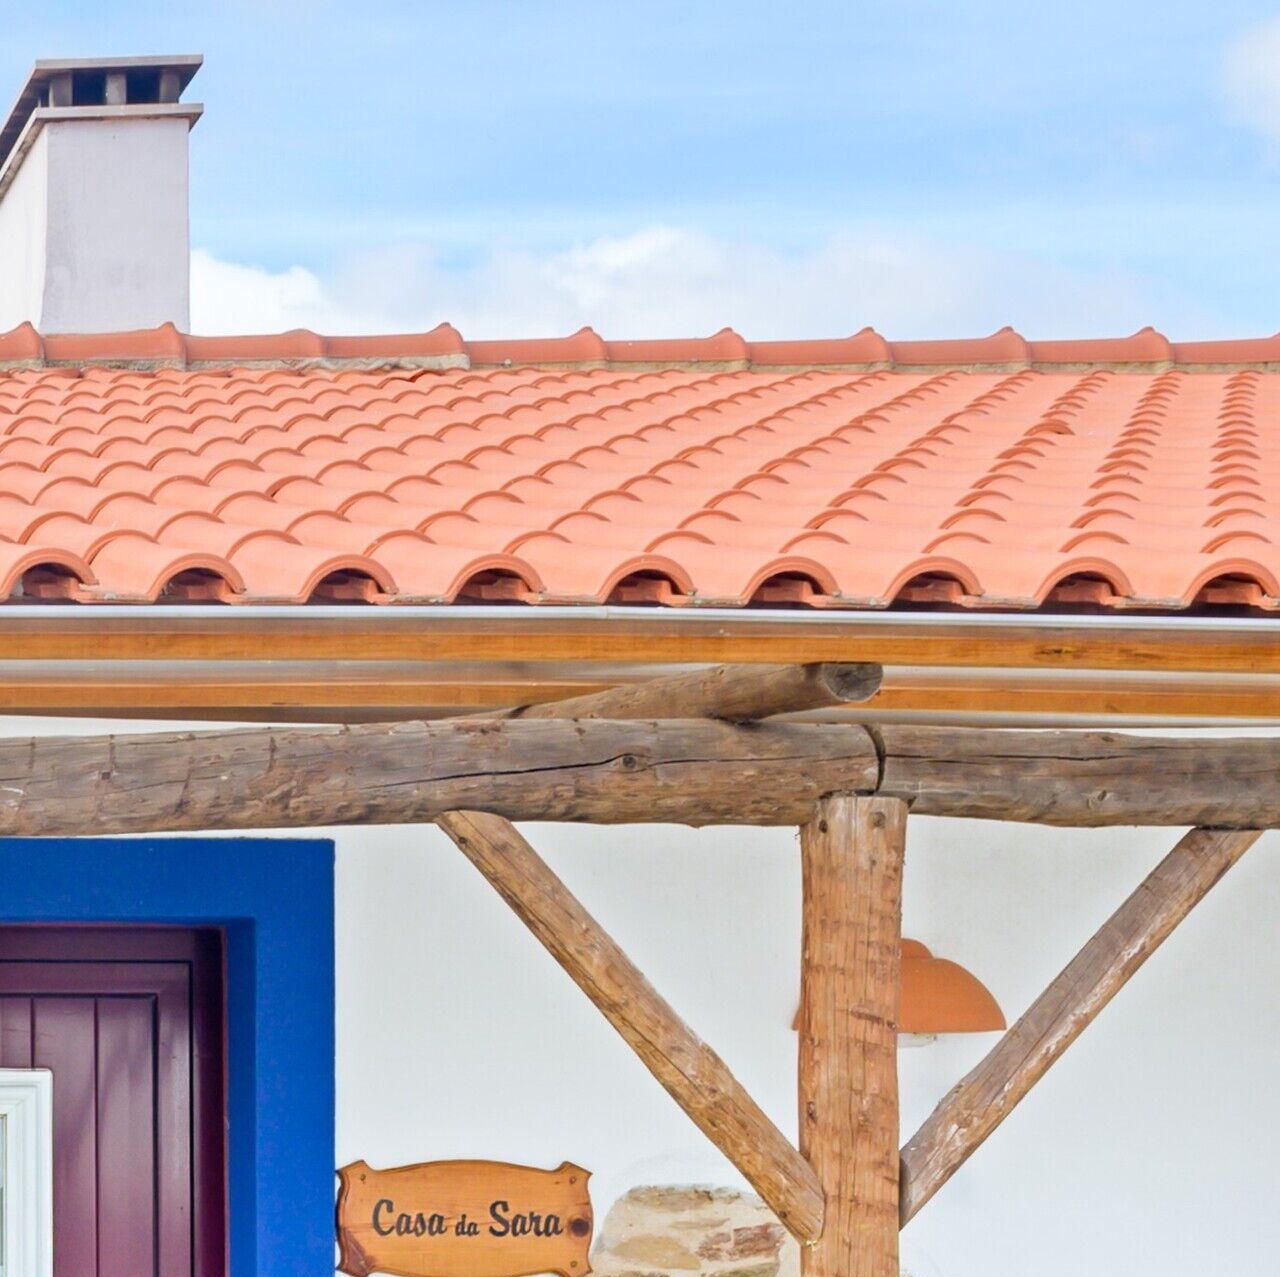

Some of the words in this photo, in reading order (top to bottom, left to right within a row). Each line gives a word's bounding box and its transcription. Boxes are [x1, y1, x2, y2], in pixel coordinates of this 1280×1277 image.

[372, 1199, 447, 1237] Casa
[455, 1214, 480, 1237] da
[488, 1200, 563, 1237] Sara
